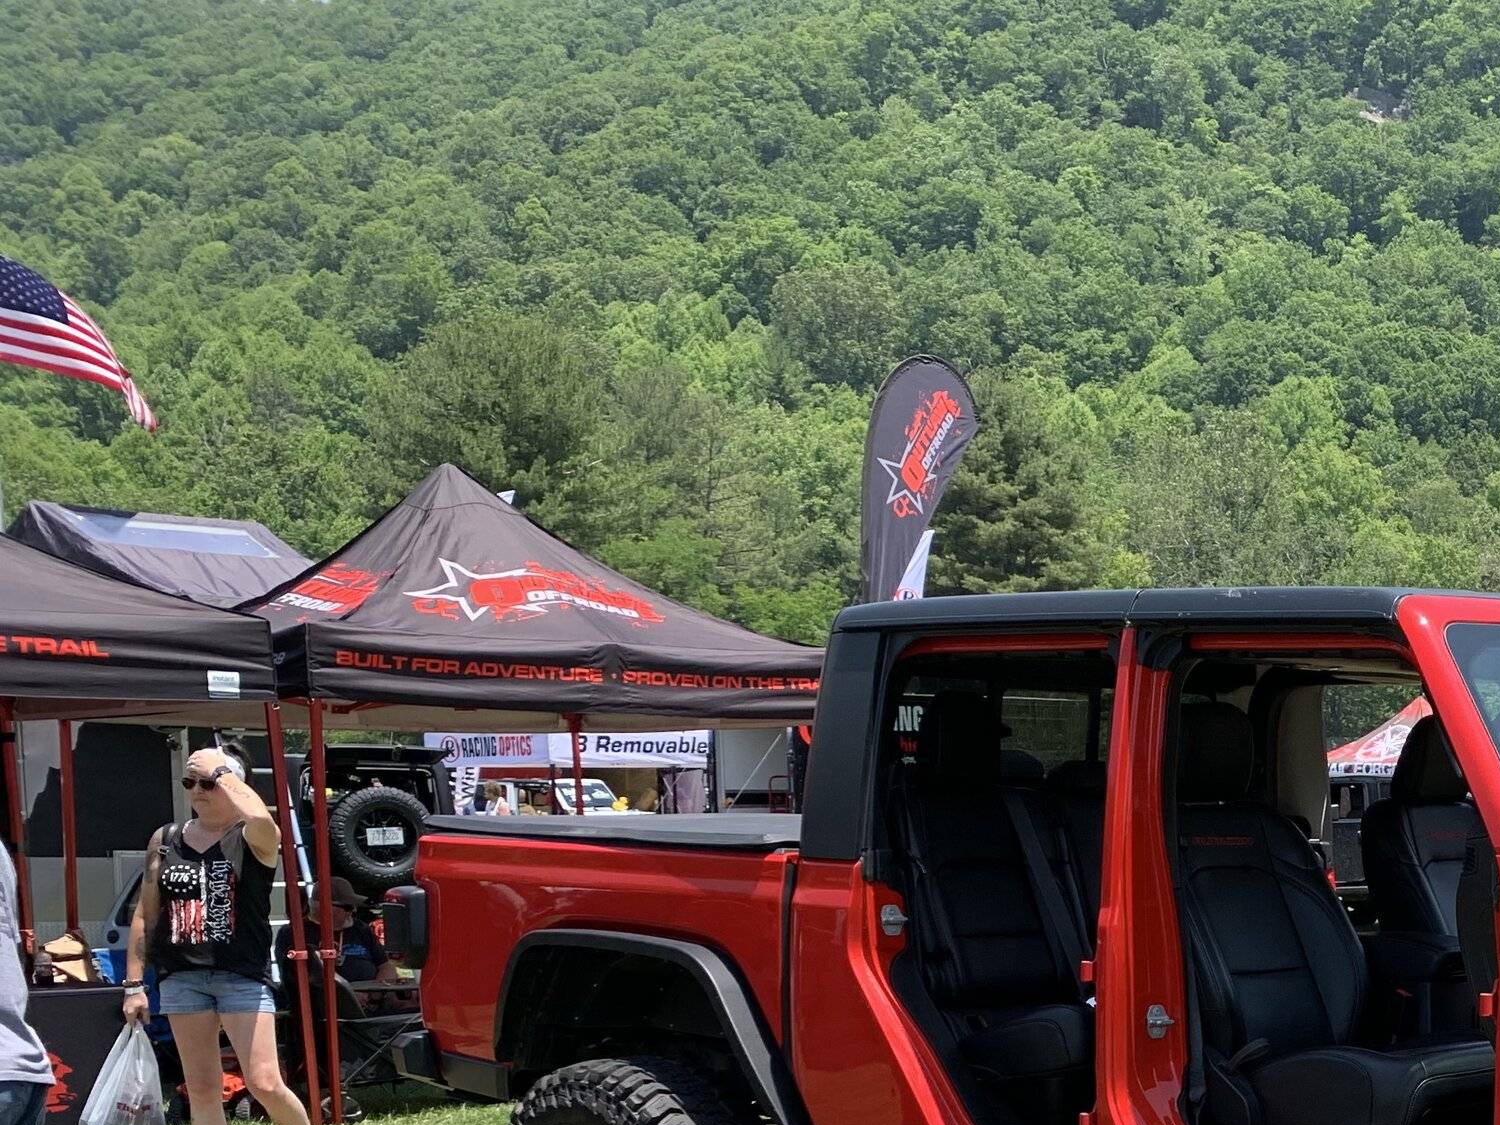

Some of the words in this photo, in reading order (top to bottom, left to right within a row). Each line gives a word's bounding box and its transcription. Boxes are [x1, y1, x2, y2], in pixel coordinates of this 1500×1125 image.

[921, 411, 954, 472] OFFROAD
[525, 591, 641, 619] OFFROAD
[11, 635, 111, 658] TRAIL
[335, 649, 409, 671] BUILT
[411, 656, 461, 676] FOR
[463, 660, 605, 686] ADVENTURE
[622, 669, 709, 688] PROVEN
[711, 673, 744, 690] ON
[742, 675, 786, 691] THE
[785, 676, 821, 691] TRA
[460, 734, 498, 758] RACING
[498, 734, 533, 756] OPTICS
[595, 734, 709, 755] Removable
[169, 872, 191, 883] 1776
